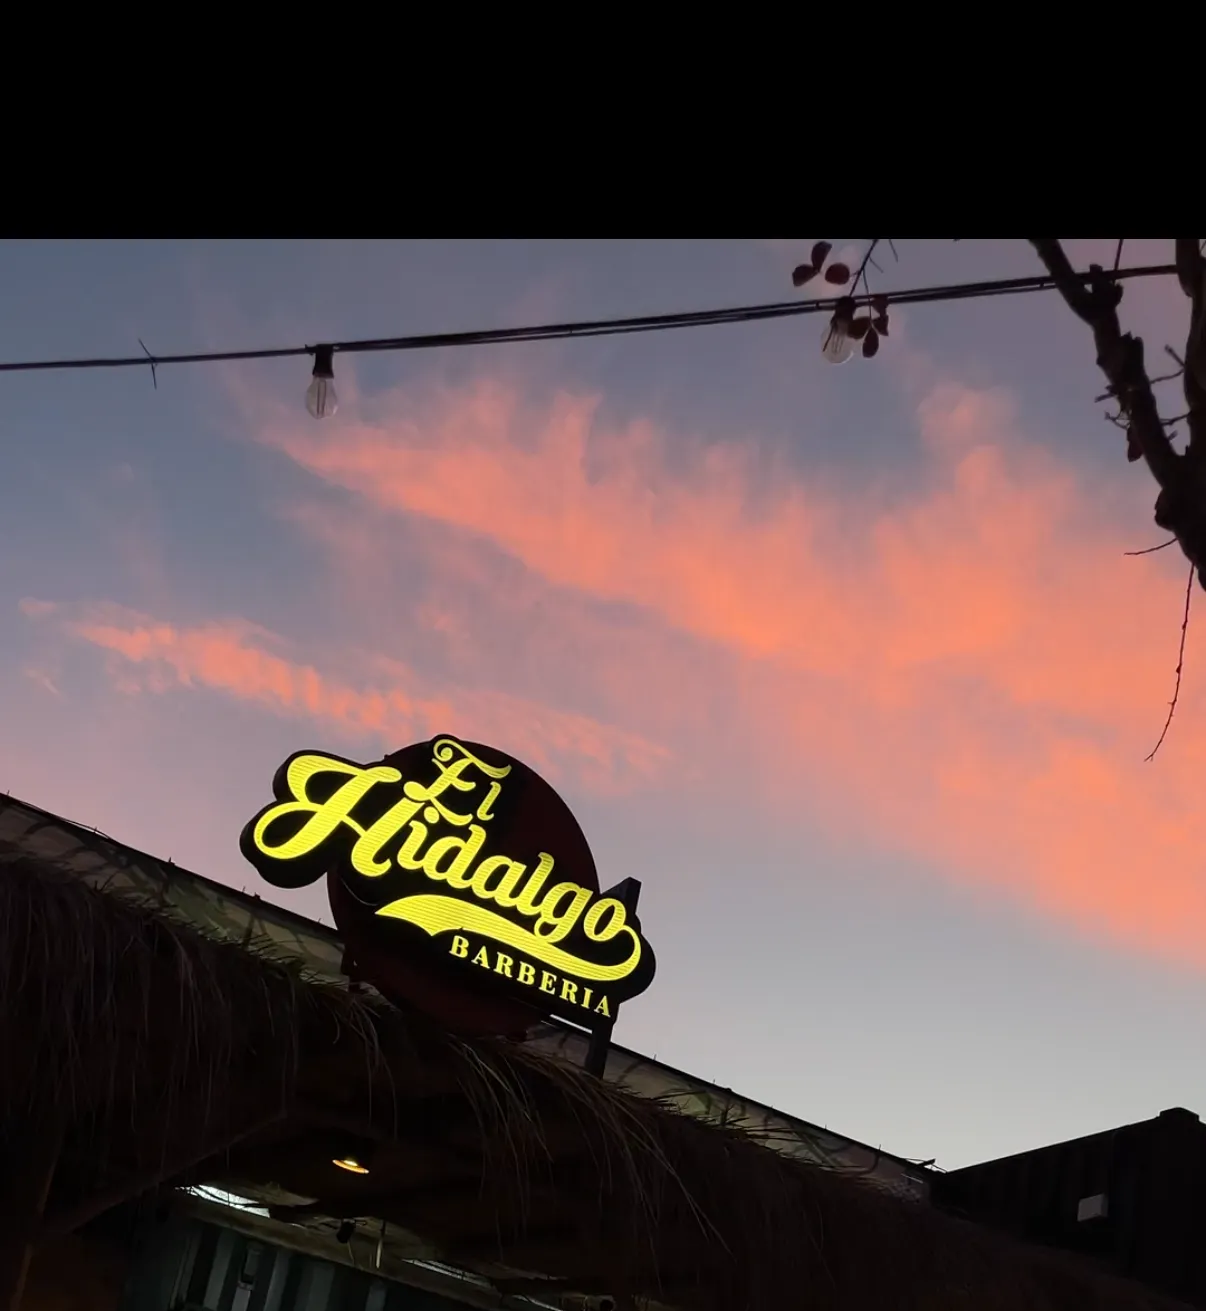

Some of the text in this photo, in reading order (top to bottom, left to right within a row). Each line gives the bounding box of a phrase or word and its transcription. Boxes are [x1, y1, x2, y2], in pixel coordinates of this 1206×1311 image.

[403, 739, 511, 826] El
[254, 755, 627, 944] Hidalgo
[449, 934, 612, 1018] BARBERIA
